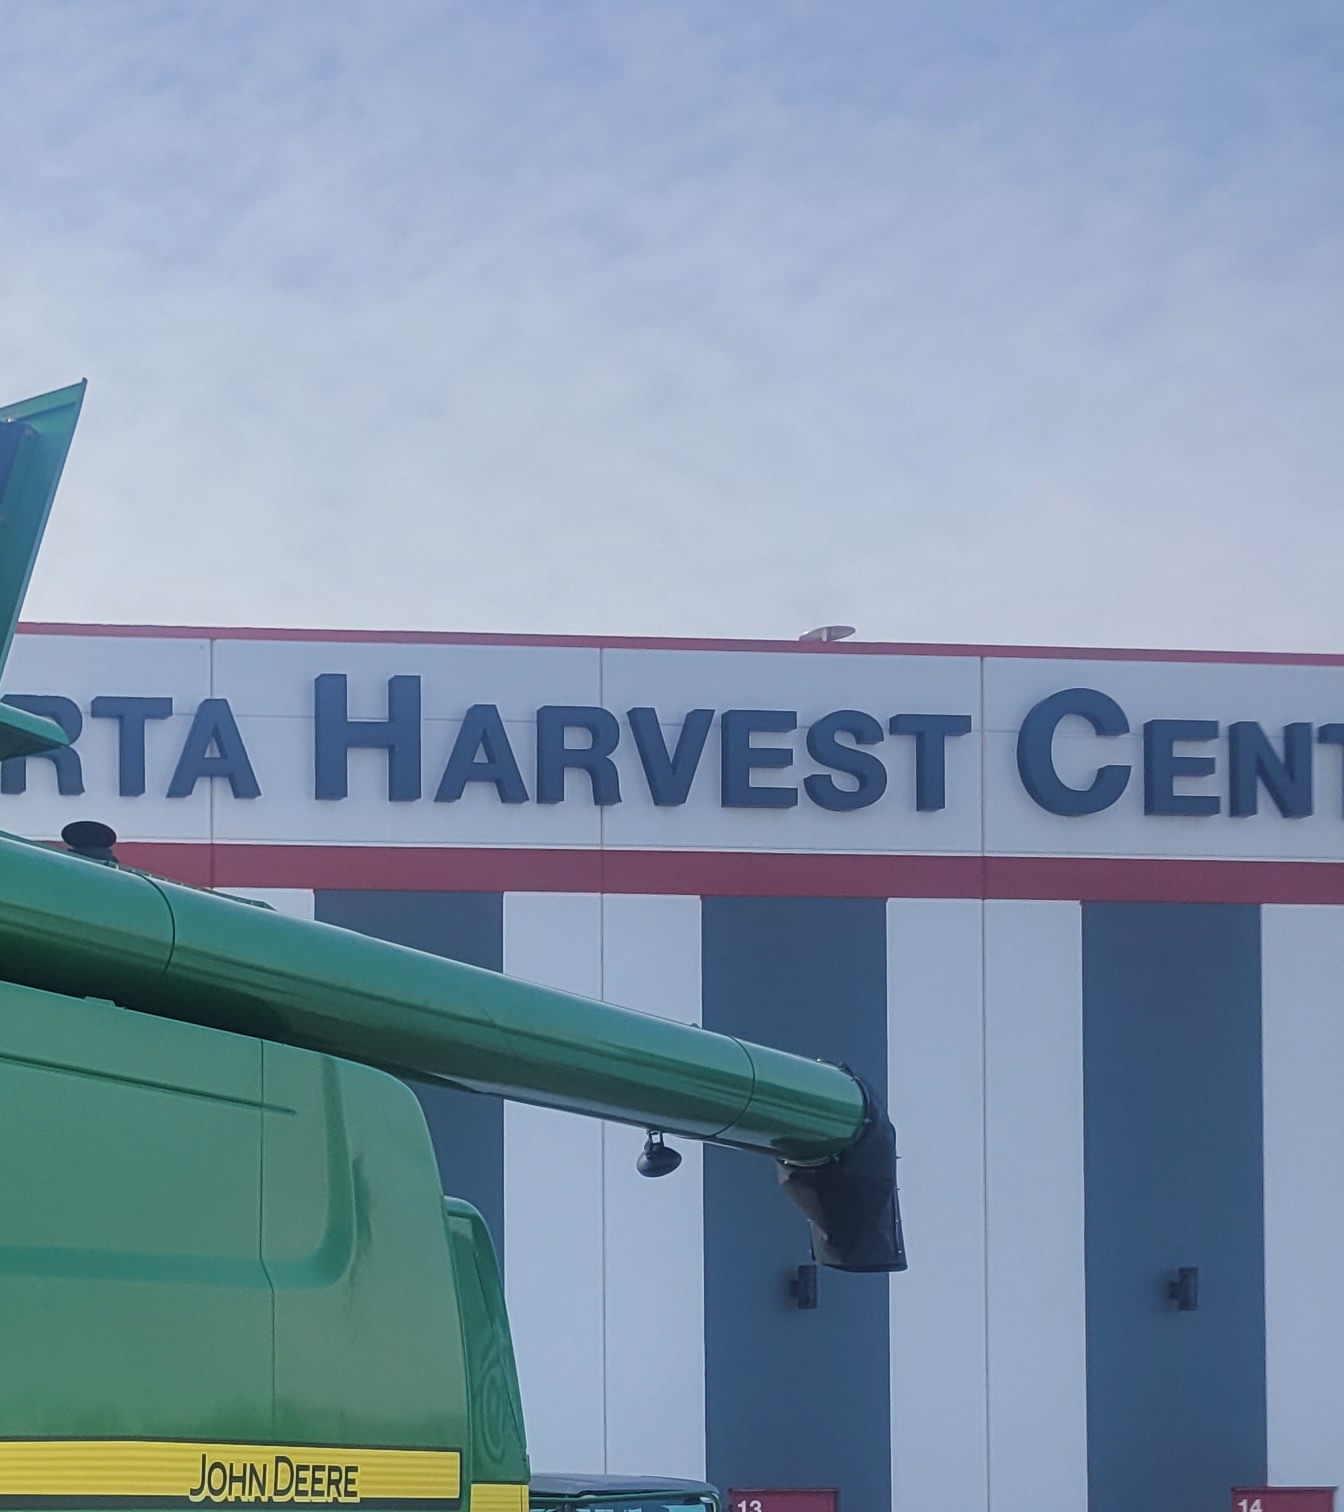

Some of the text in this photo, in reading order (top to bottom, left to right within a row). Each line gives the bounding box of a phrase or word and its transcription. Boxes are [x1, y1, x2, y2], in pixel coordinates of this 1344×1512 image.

[314, 673, 972, 812] HARVEST
[189, 1452, 360, 1500] JOHN DEERE
